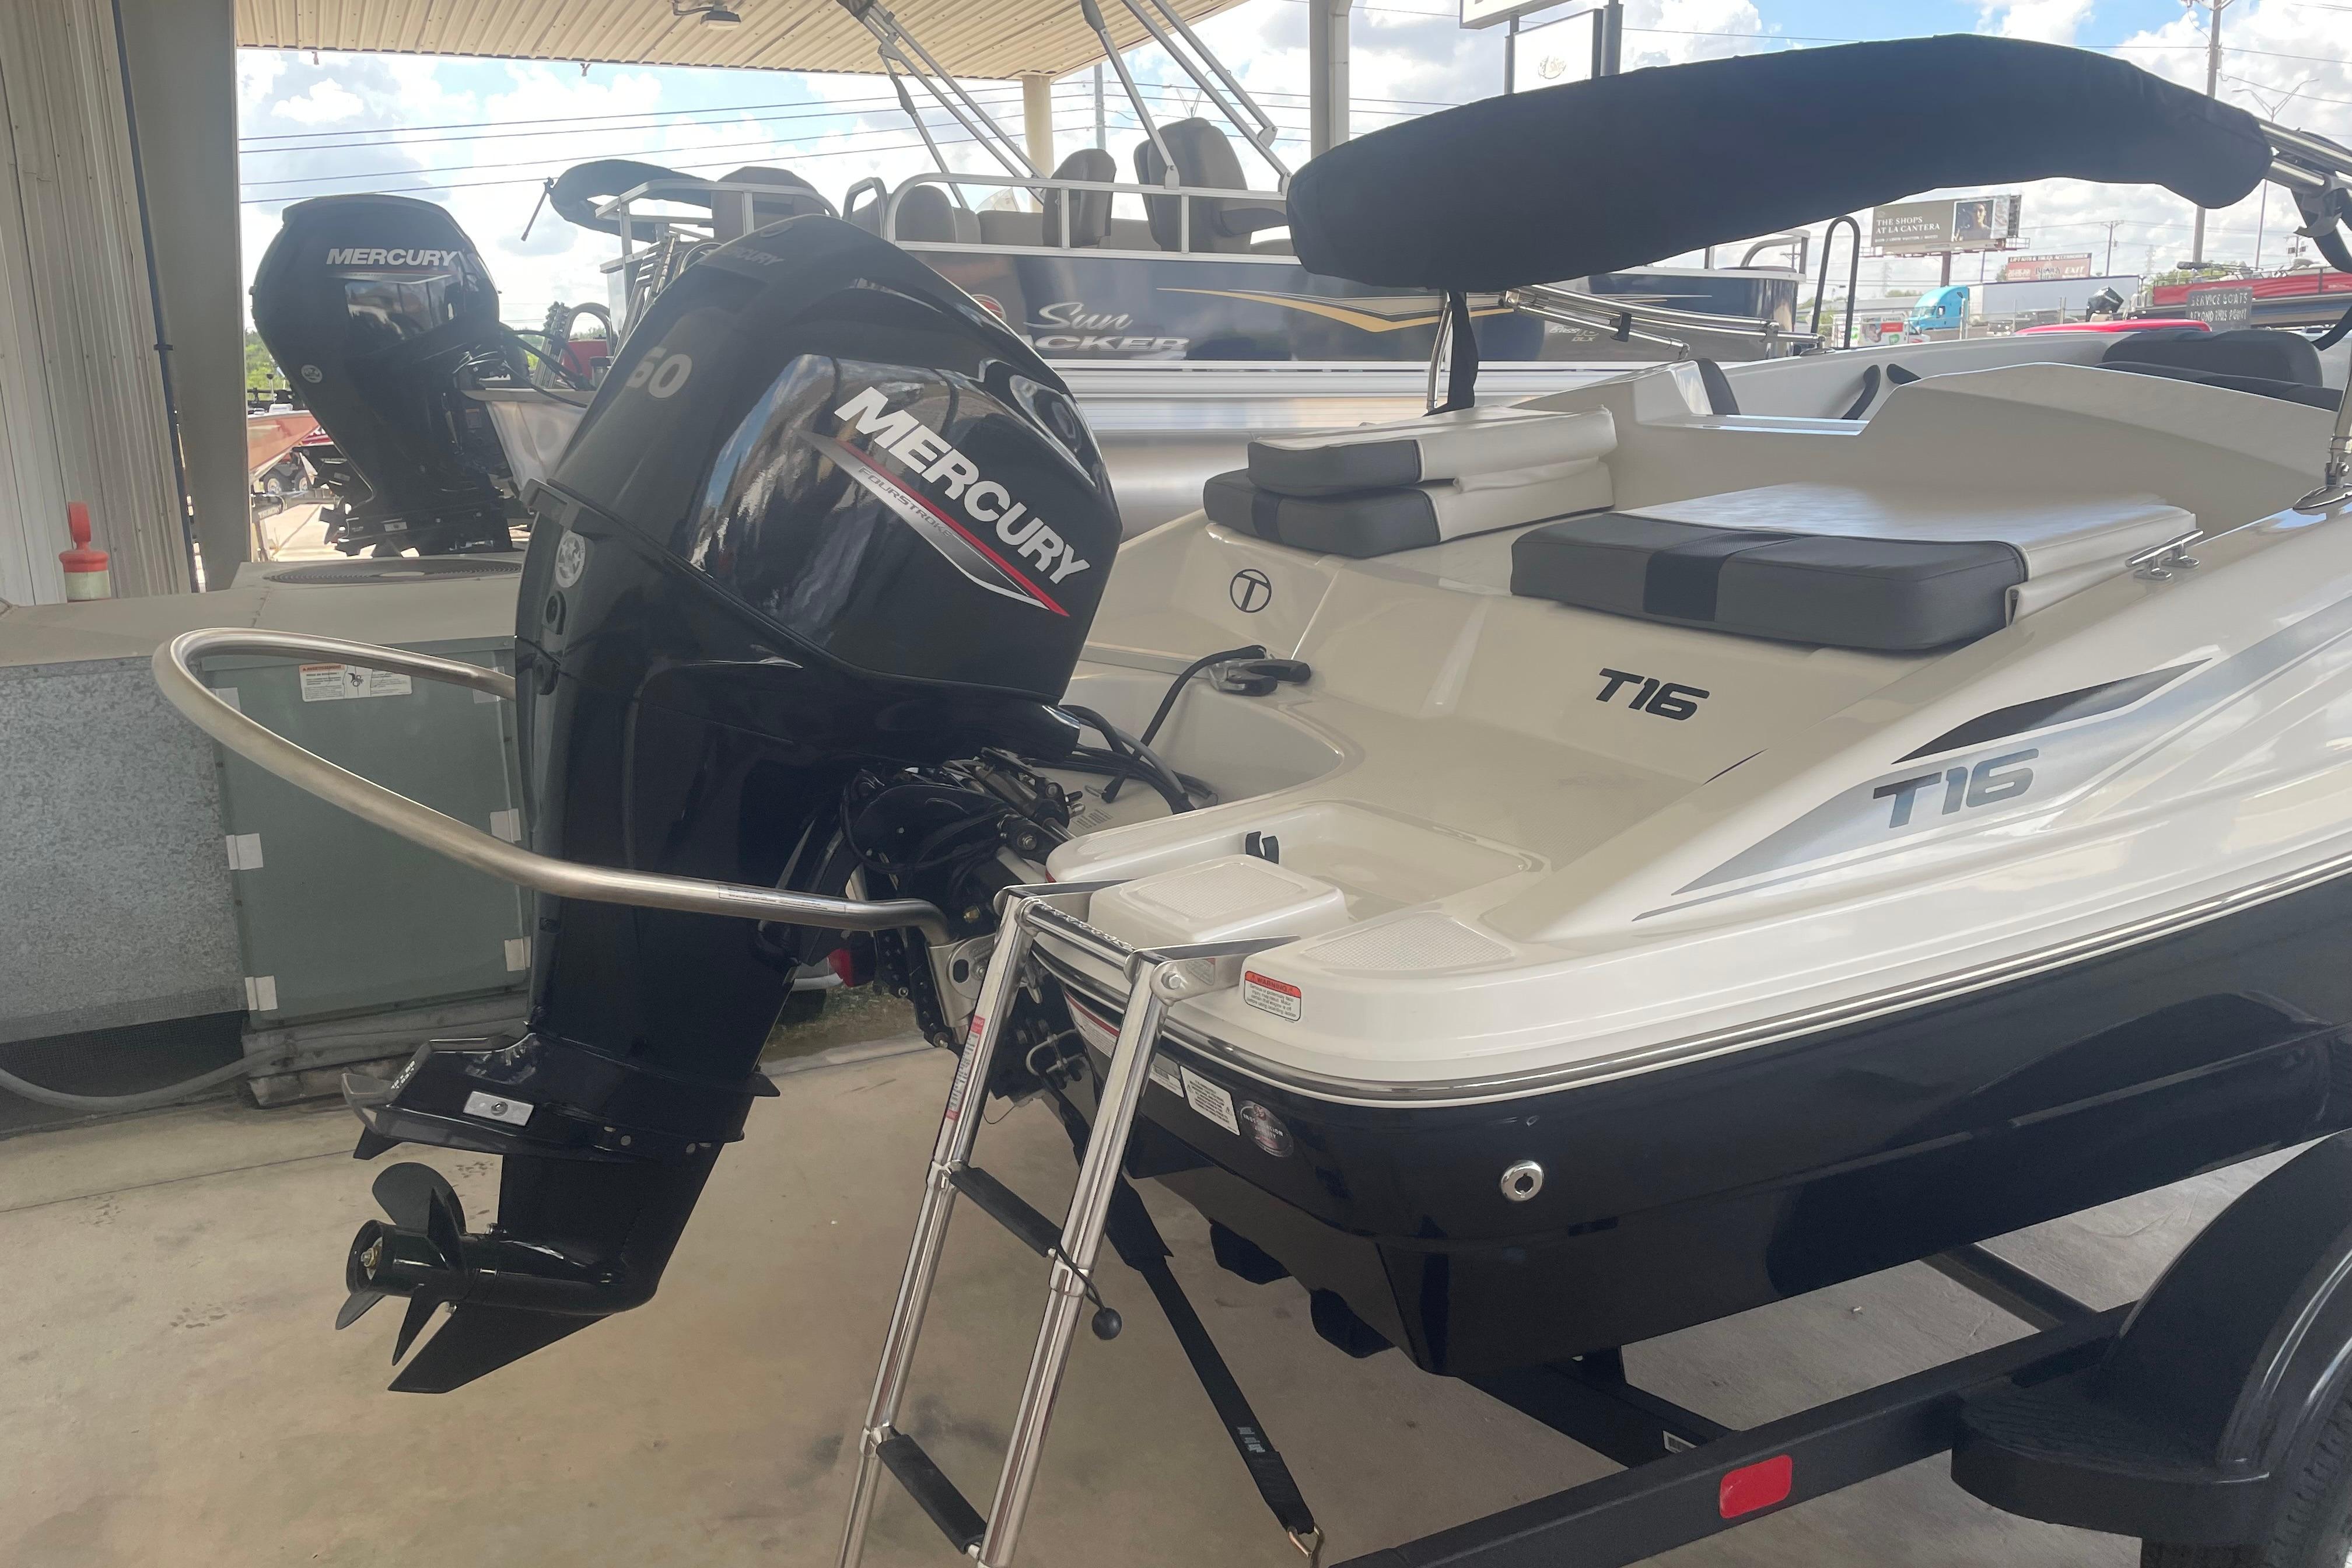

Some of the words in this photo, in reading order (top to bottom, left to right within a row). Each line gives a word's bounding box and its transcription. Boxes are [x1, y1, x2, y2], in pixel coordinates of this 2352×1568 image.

[1876, 218, 1894, 226] THE
[1895, 216, 1923, 225] SHOPS
[1901, 223, 1940, 233] CANTERA
[326, 249, 458, 267] MERCURY
[2064, 266, 2085, 274] EXIT
[1022, 302, 1133, 331] Sun
[834, 386, 1090, 583] MERCURY
[859, 466, 952, 537] FOURSTROKE
[1595, 667, 1710, 720] T16
[1873, 748, 2039, 828] T16
